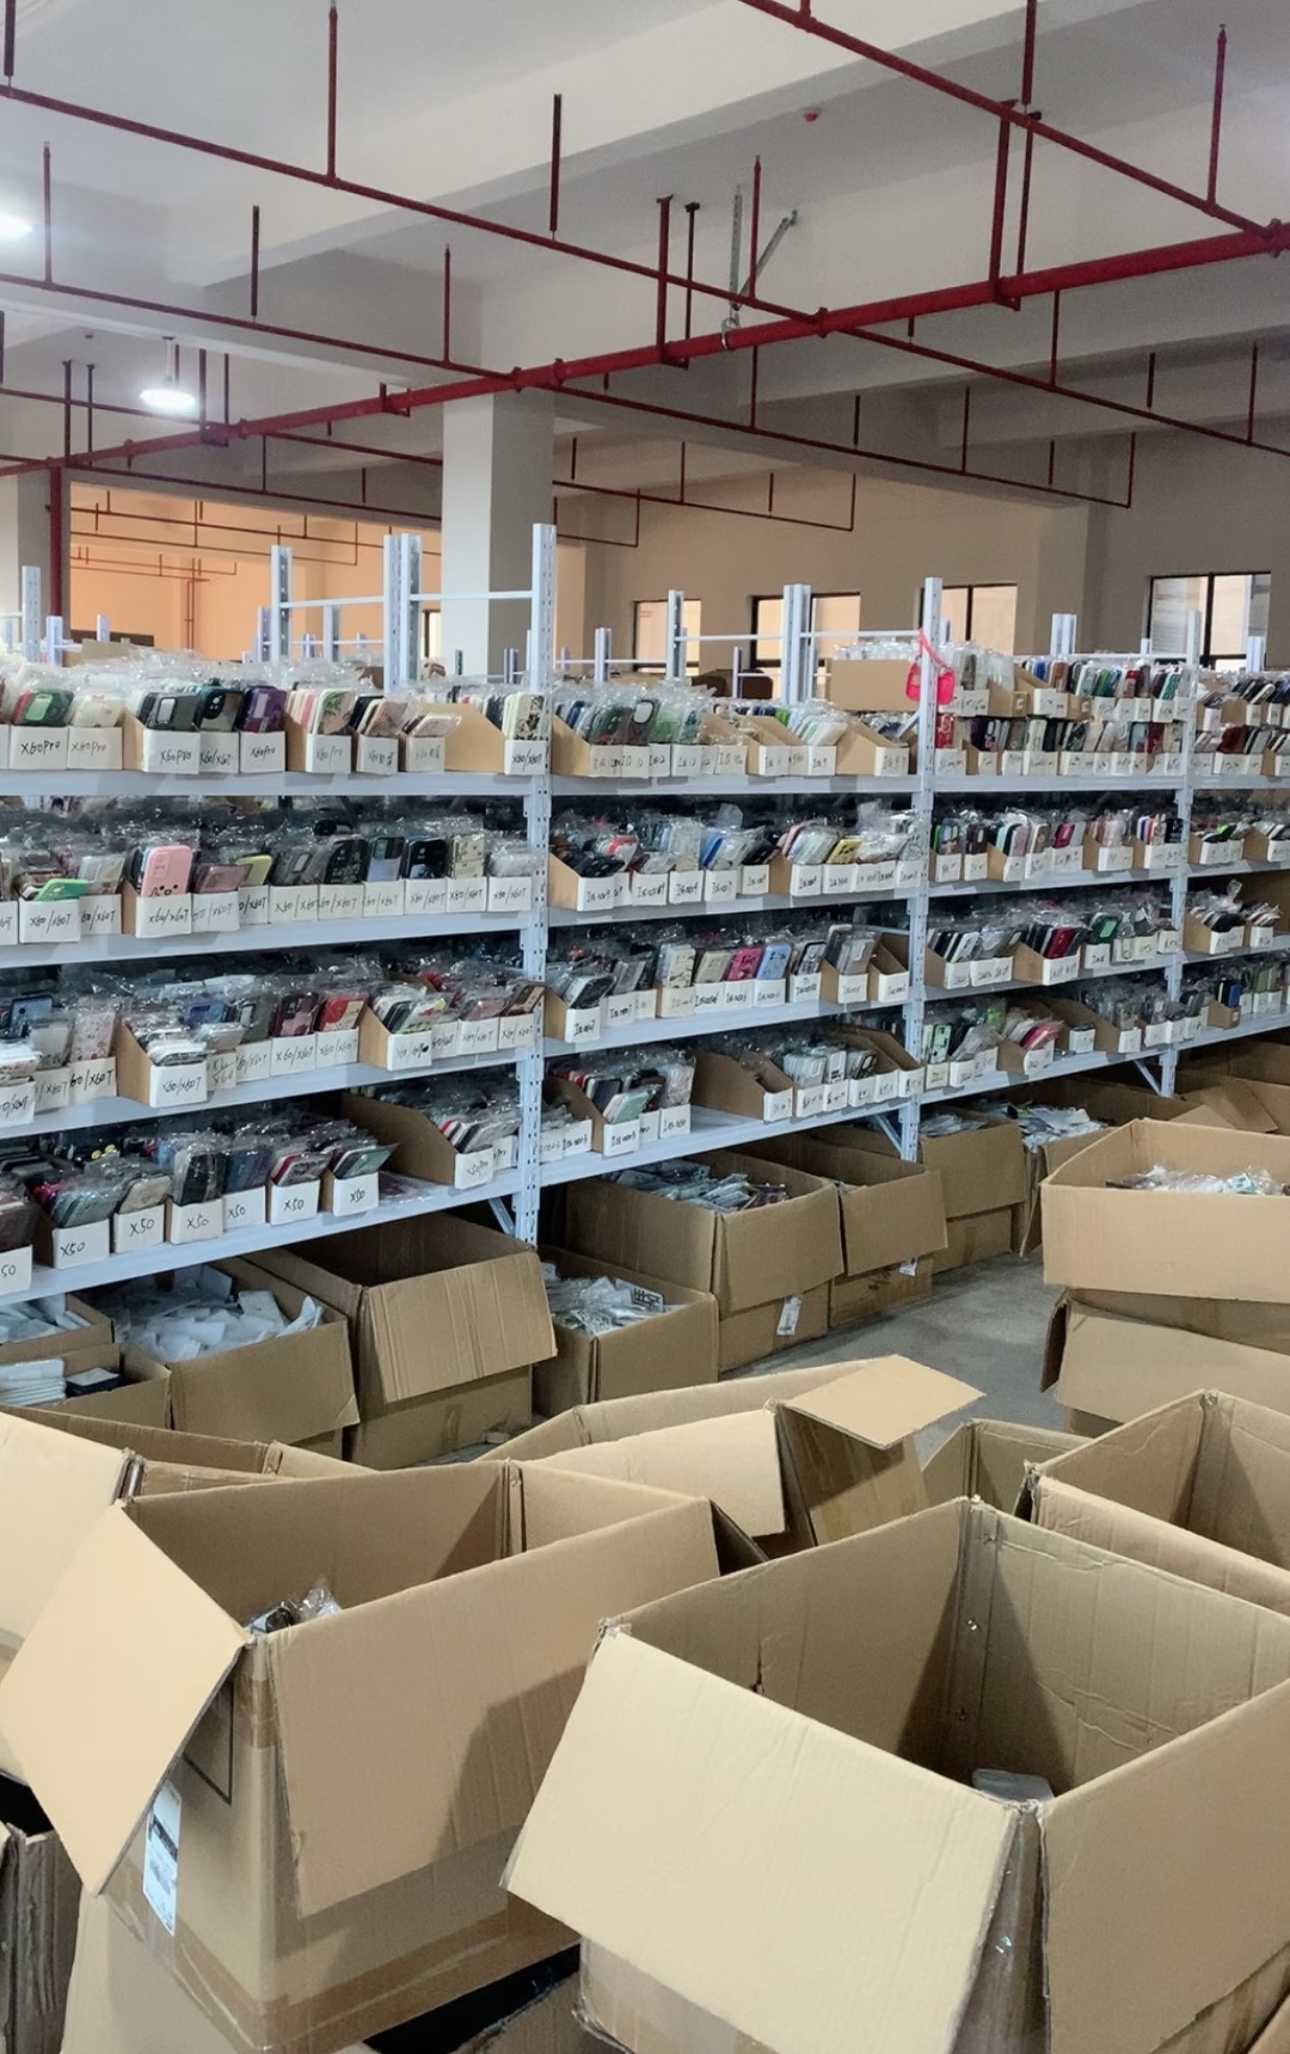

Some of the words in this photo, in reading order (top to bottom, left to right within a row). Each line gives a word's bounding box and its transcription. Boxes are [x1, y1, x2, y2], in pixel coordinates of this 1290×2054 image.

[70, 1069, 113, 1091] 60/X60T
[228, 1204, 246, 1219] X50
[283, 1198, 304, 1212] X50
[130, 1218, 155, 1237] X50
[186, 1213, 209, 1229] X50
[61, 1241, 86, 1257] X50
